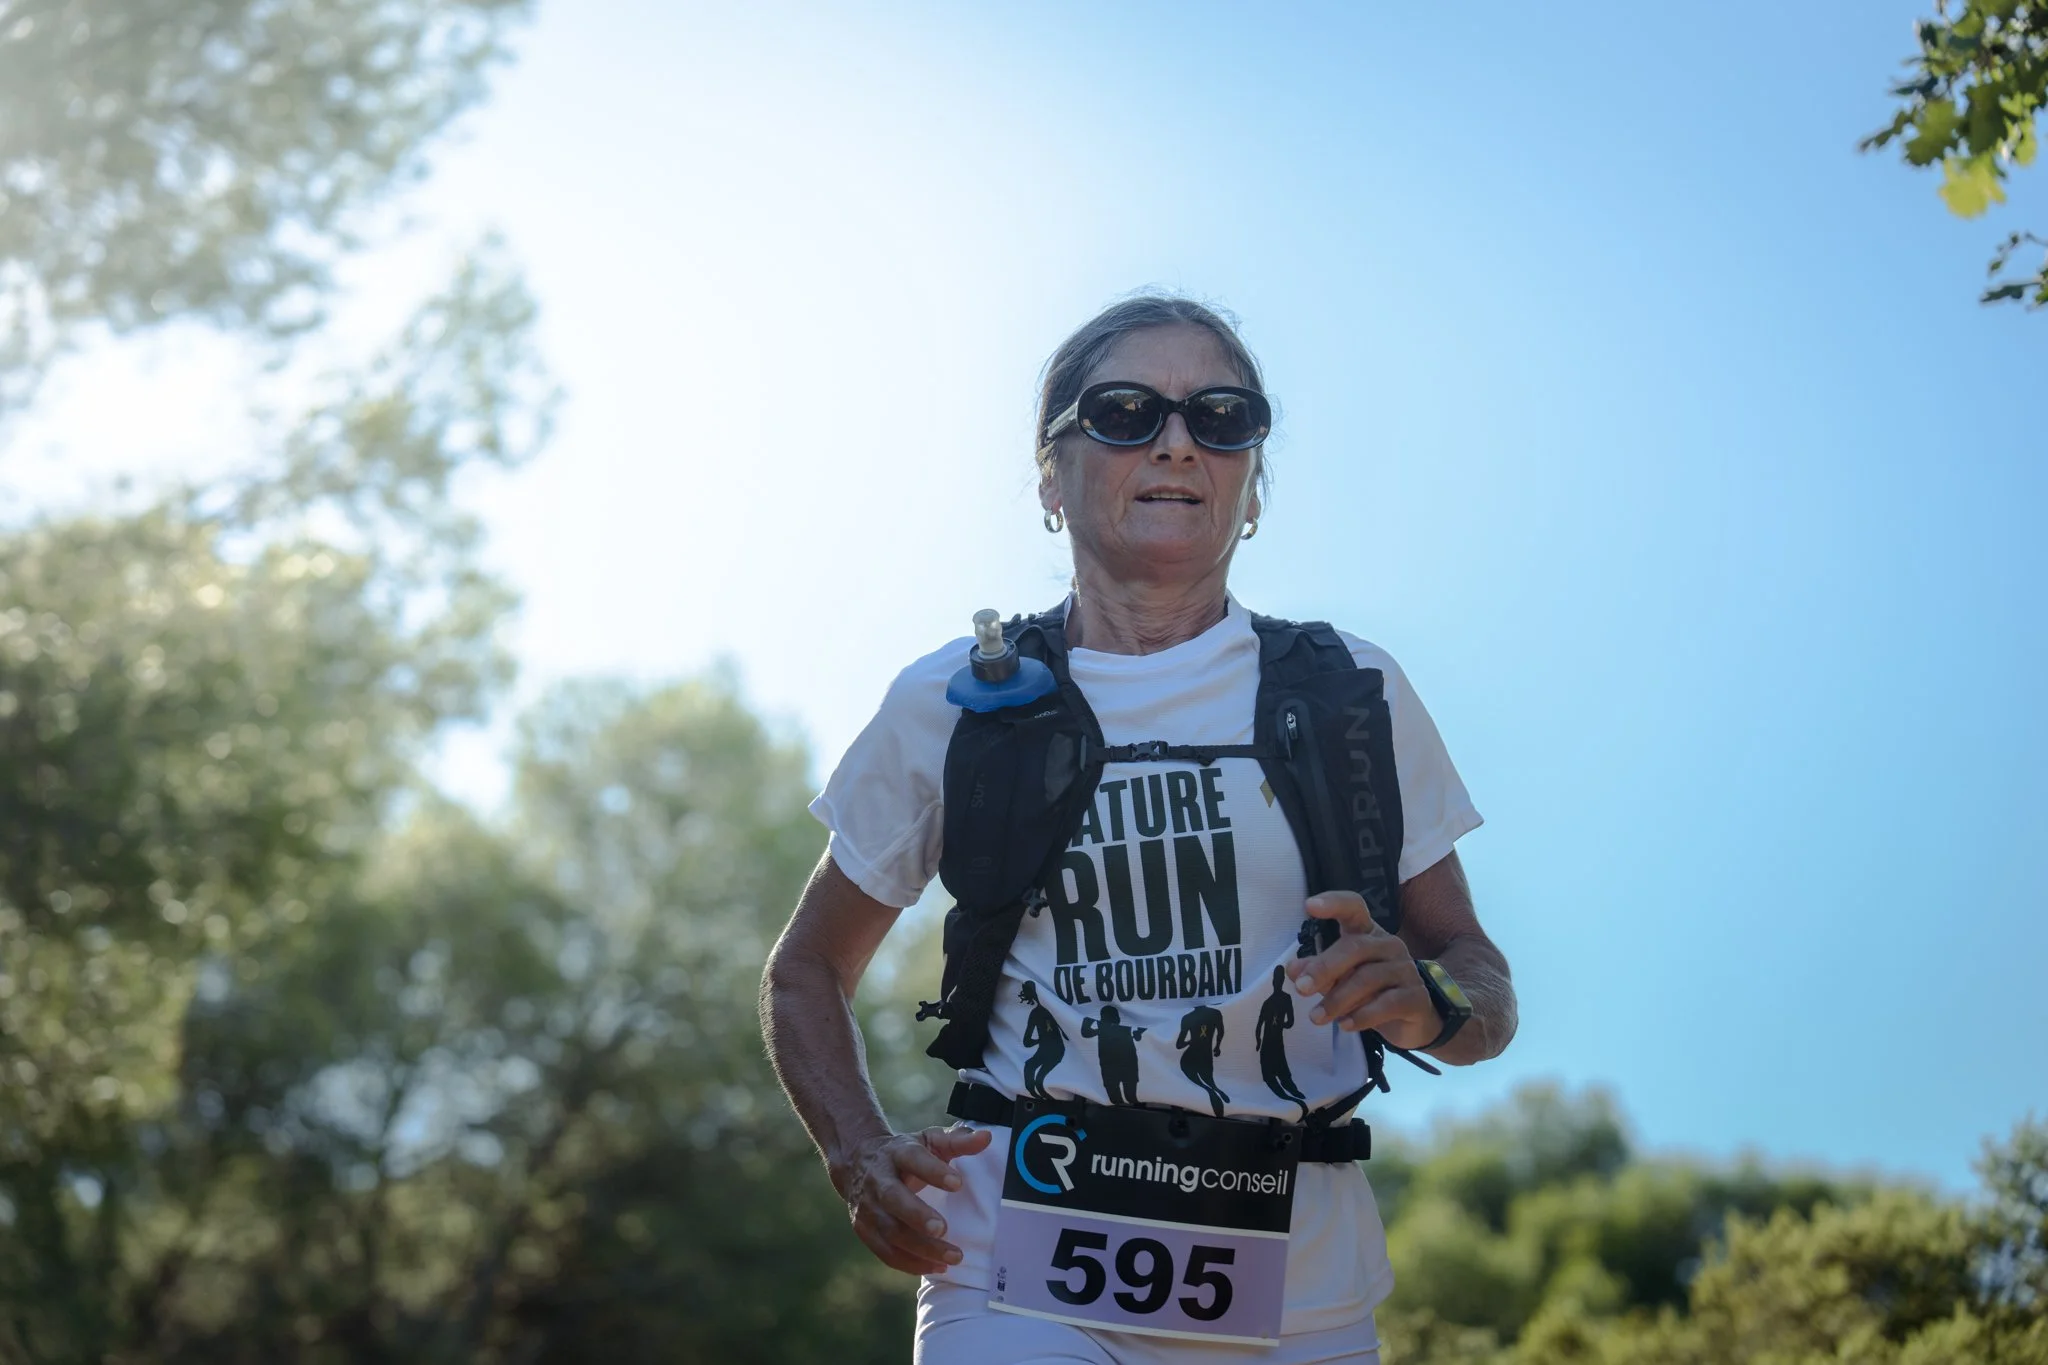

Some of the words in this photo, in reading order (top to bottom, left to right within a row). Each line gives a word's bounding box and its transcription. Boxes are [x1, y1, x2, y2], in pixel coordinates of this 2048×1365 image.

[1067, 767, 1232, 848] ATURE
[1345, 706, 1391, 918] KIPRUN
[1045, 831, 1241, 965] RUN
[1053, 964, 1092, 1006] DE
[1095, 947, 1242, 1002] BOURBAKI
[1091, 1152, 1289, 1195] runningconseil
[1045, 1228, 1236, 1322] 595
